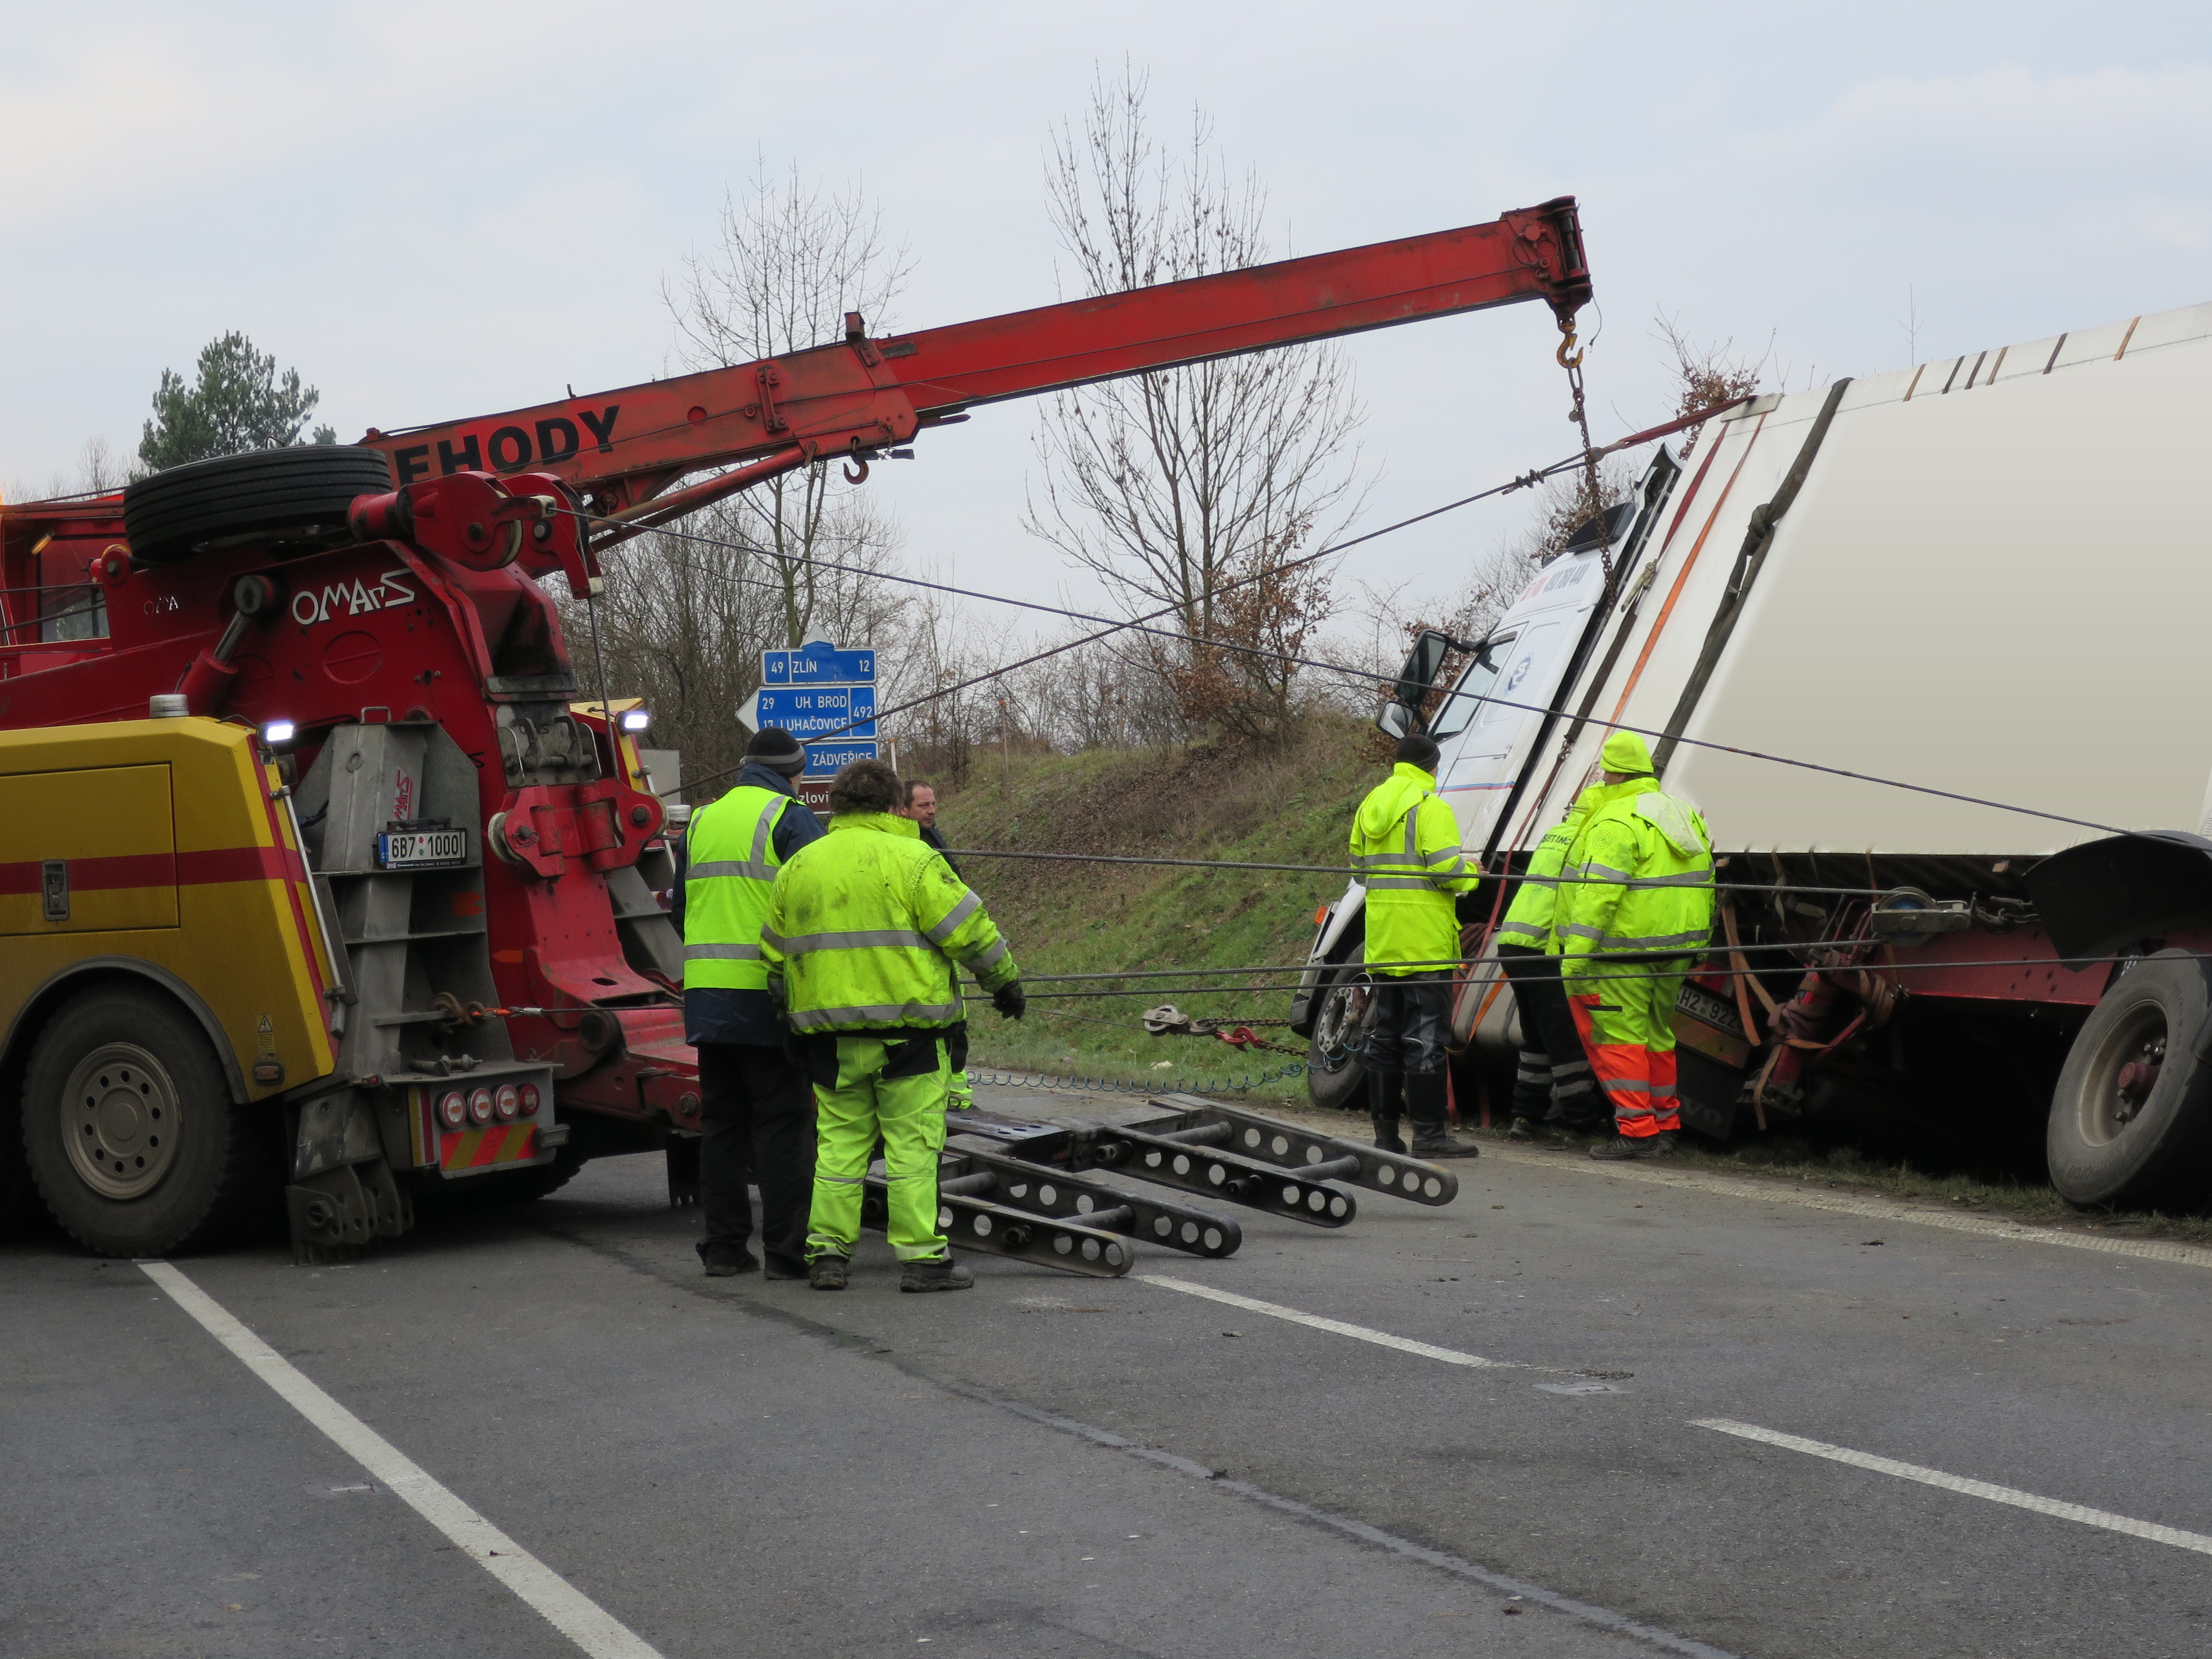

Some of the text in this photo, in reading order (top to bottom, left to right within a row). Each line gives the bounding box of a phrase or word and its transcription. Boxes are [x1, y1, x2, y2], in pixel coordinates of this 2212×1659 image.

[771, 661, 784, 674] 49
[792, 658, 870, 674] ZLÍN 12
[762, 697, 774, 709] 29
[817, 696, 847, 708] BROD
[853, 706, 873, 718] 492
[799, 791, 829, 804] zlovi
[392, 834, 458, 858] 6B7 1000
[1677, 988, 1701, 1011] H2
